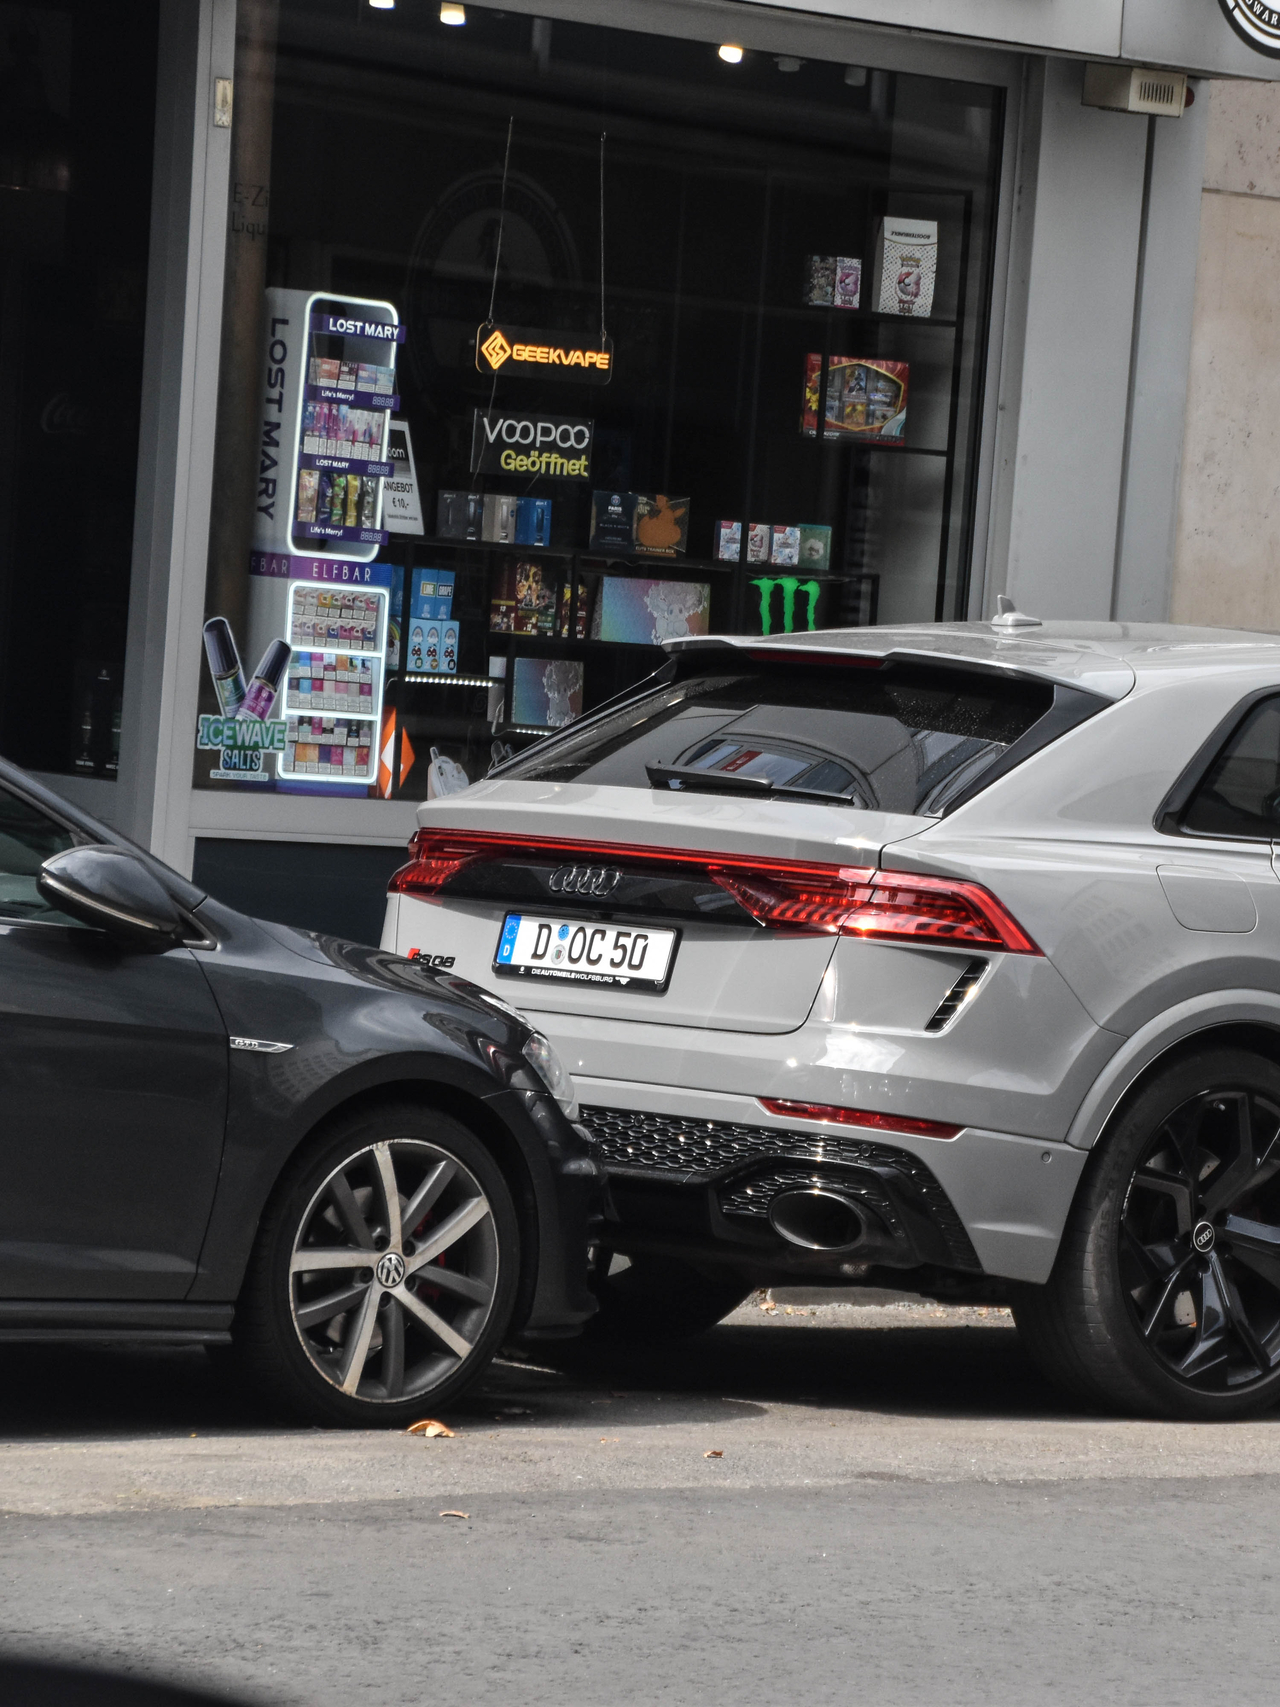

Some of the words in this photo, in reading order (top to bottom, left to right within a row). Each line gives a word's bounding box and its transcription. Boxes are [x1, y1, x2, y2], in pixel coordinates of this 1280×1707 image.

[329, 317, 363, 334] LOST
[365, 323, 399, 340] MARY
[265, 318, 289, 413] LOST
[512, 343, 610, 370] GEEKVAPE
[321, 389, 336, 398] Life's
[337, 392, 355, 401] Merry!
[483, 417, 590, 449] VOOPOO
[256, 421, 281, 520] MARY
[316, 459, 331, 467] LOST
[332, 461, 349, 469] MARY
[500, 450, 589, 477] Geöffnet
[384, 481, 413, 494] ANGEBOT
[392, 497, 397, 508] €
[310, 526, 325, 535] Life's
[325, 527, 343, 537] Merry!
[312, 563, 371, 581] ELFBAR
[200, 720, 287, 750] ICEWAVE
[223, 750, 261, 771] SALTS
[503, 945, 510, 956] D
[531, 924, 552, 960] D
[568, 926, 606, 966] OC
[610, 932, 648, 970] 50
